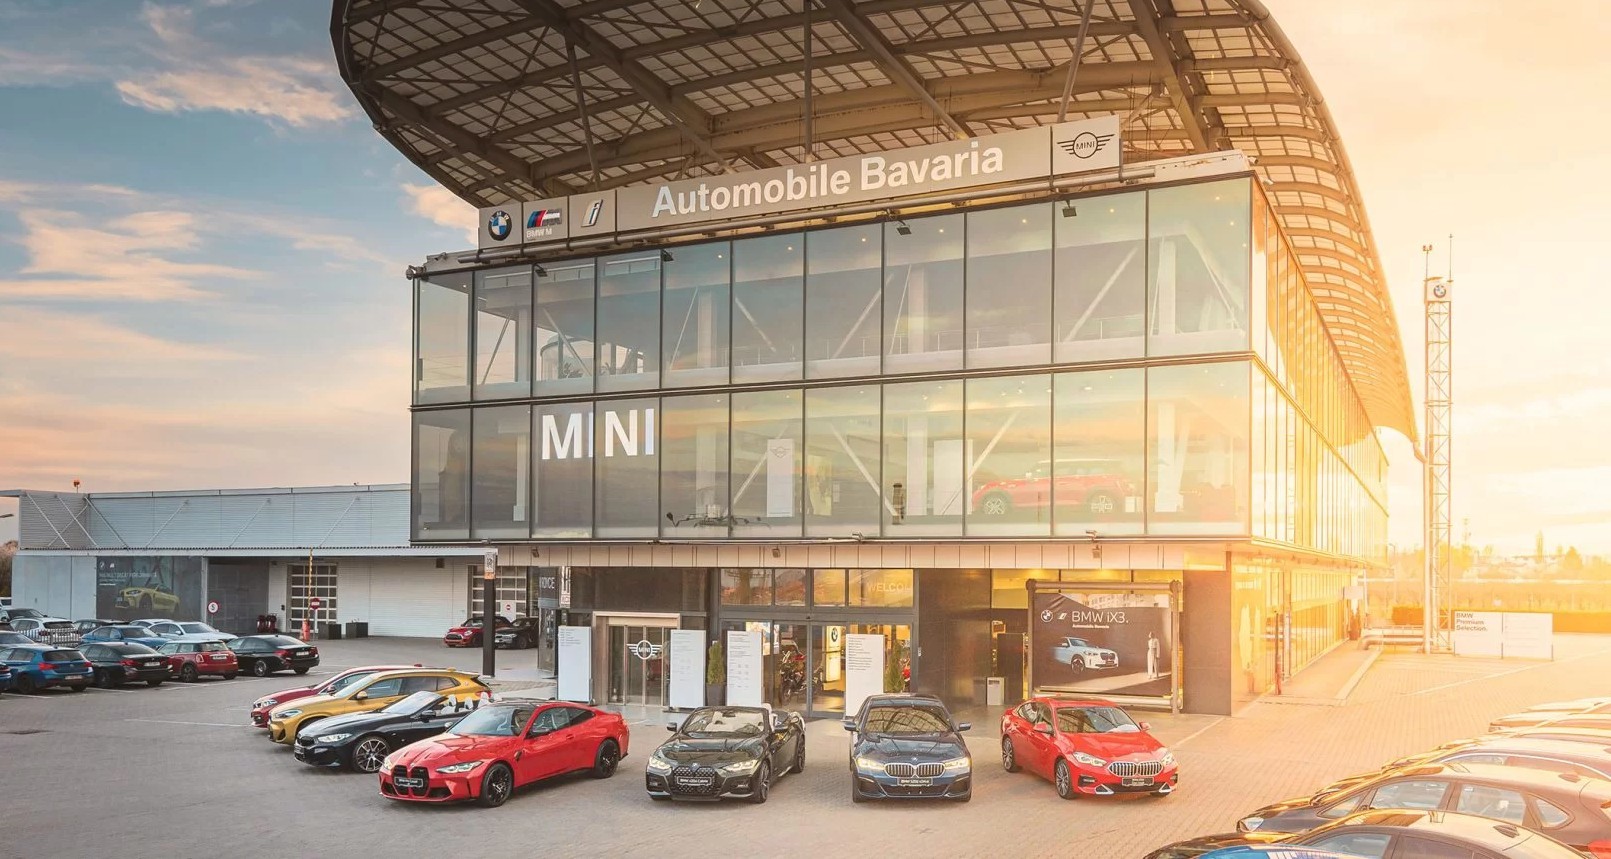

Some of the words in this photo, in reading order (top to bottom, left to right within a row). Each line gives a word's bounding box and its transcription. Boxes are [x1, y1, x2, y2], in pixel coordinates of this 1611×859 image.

[1076, 141, 1095, 150] MINI
[651, 166, 851, 218] Automobile
[860, 141, 1004, 191] Bavaria
[526, 229, 545, 238] BMW
[542, 408, 655, 460] MINI
[1072, 611, 1104, 623] BMW
[1107, 611, 1129, 624] iX3.
